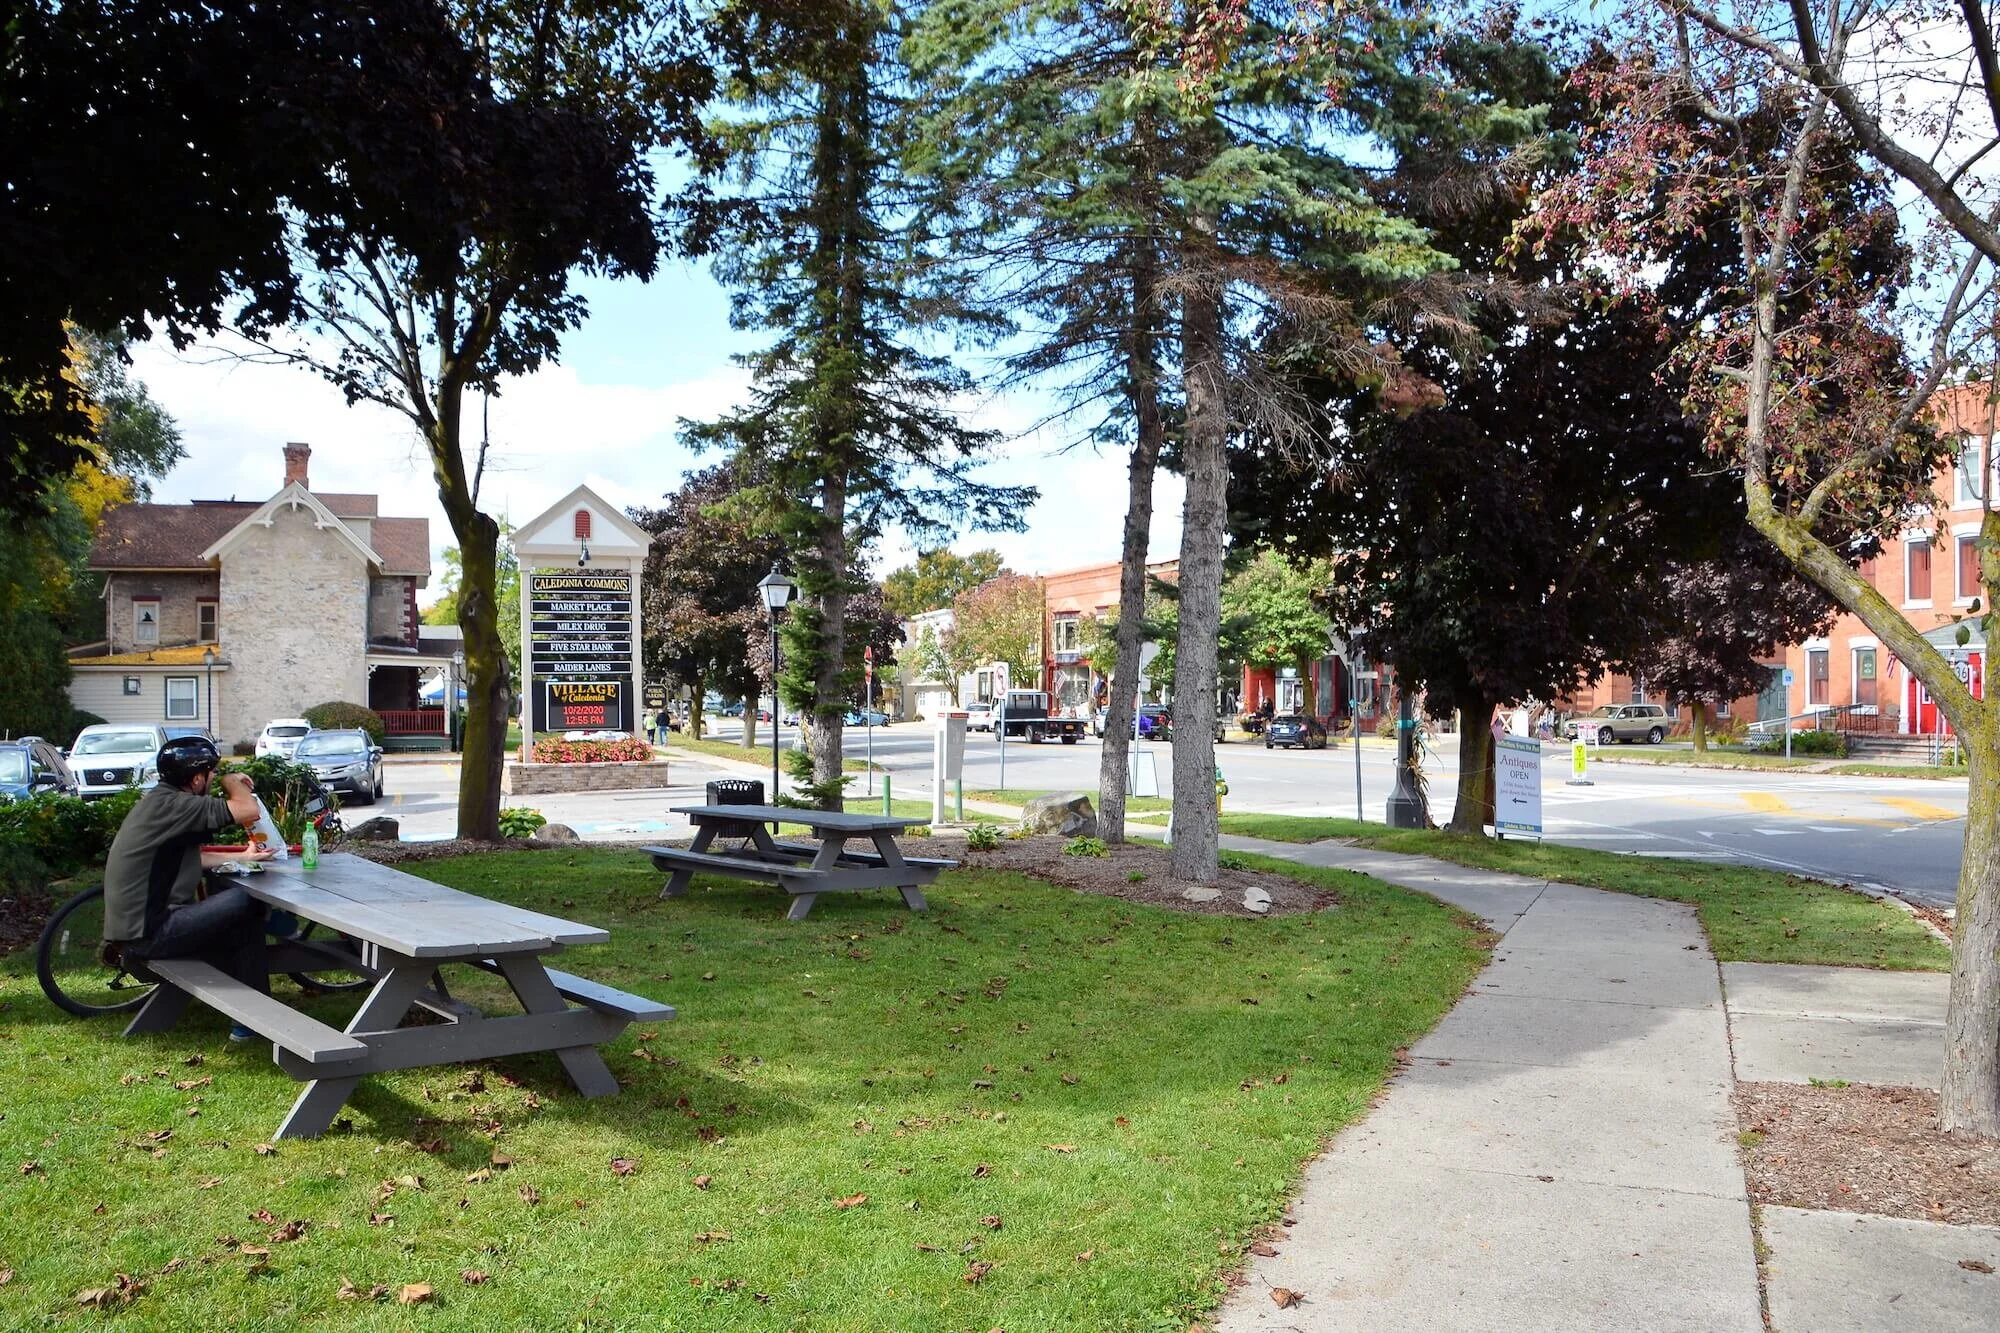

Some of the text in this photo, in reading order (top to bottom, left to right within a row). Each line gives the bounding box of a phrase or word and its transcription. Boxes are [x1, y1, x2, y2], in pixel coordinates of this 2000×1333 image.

[534, 578, 628, 591] CALEDONIA COMMONS
[551, 602, 612, 611] MARKET PLACE
[556, 622, 607, 631] MILEX DRUG
[550, 643, 614, 651] FIVE STAR BANK
[554, 663, 584, 672] RAIDER
[552, 684, 617, 698] VILLAGE
[561, 693, 606, 703] of Caledonia
[563, 705, 604, 715] 10/2/2020
[565, 715, 605, 725] 12:55 PM
[1500, 754, 1538, 770] Antiques
[1510, 770, 1529, 780] OPEN
